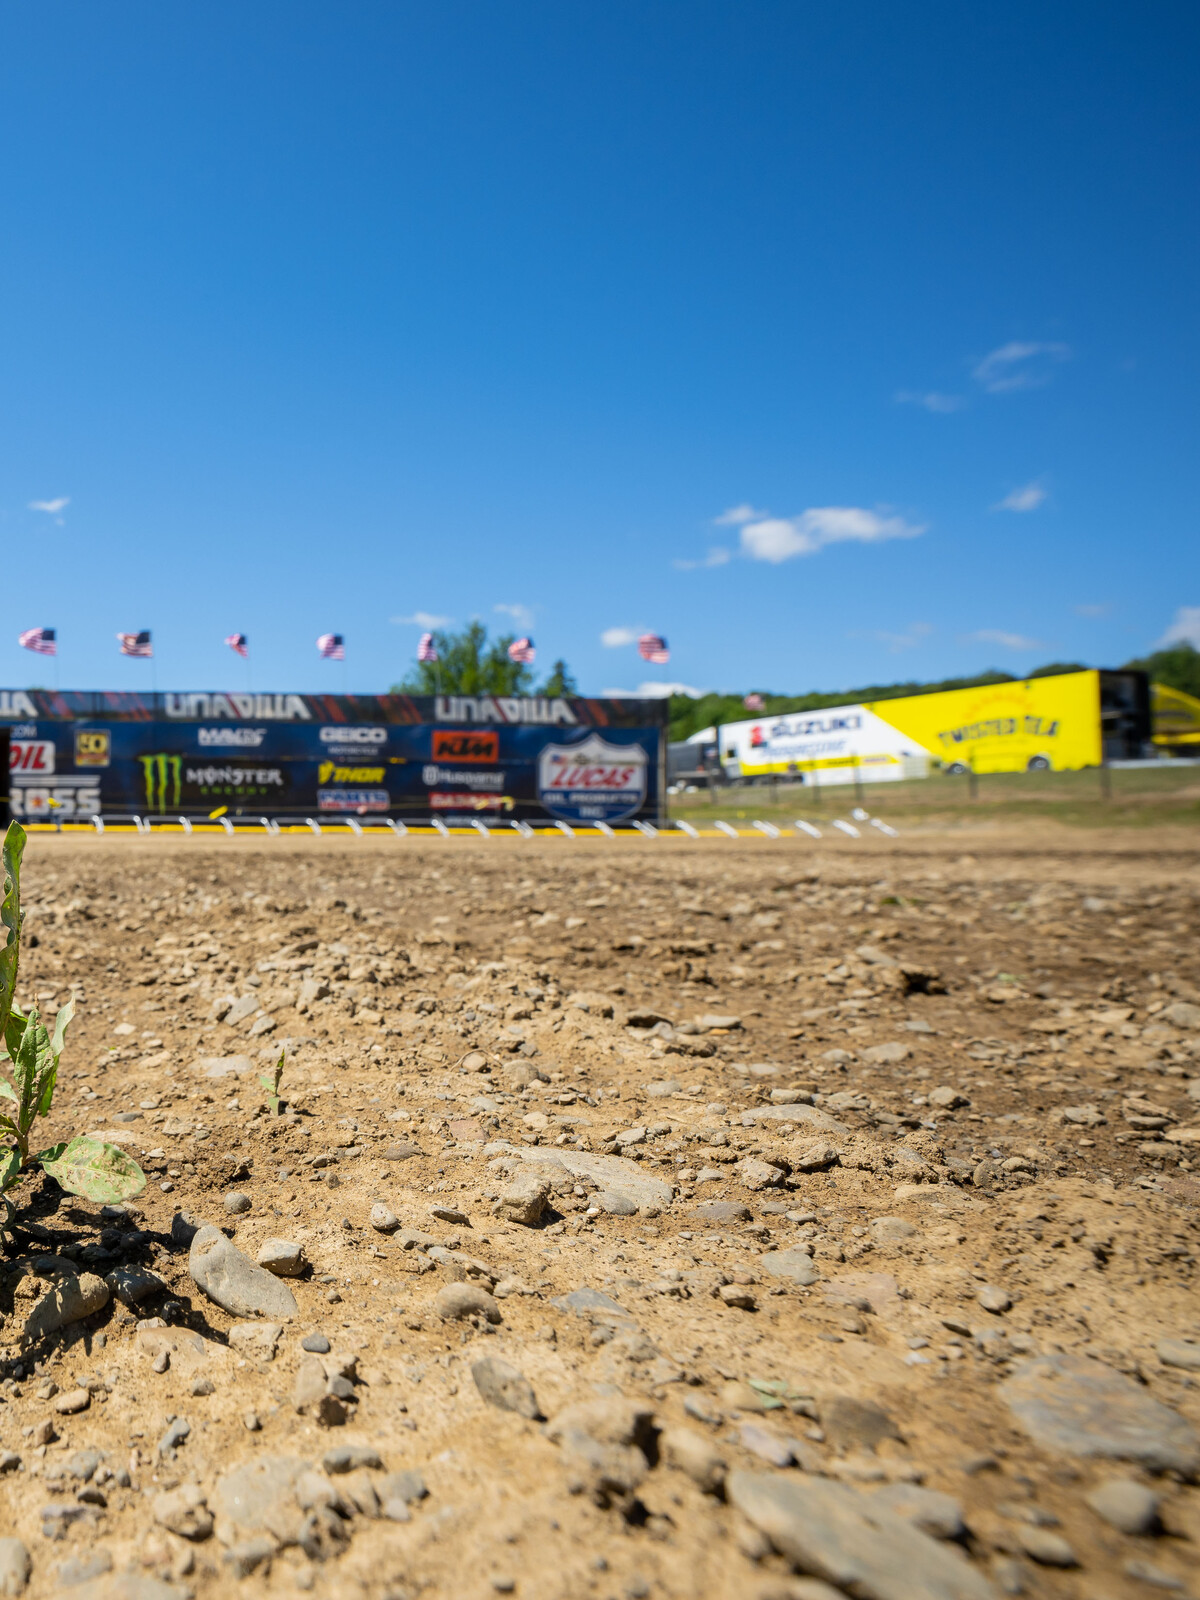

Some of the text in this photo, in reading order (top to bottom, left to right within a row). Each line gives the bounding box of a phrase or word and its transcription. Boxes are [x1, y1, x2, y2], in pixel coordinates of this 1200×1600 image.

[165, 693, 313, 720] UNADILLA
[435, 696, 578, 723] UNADILLA
[319, 727, 388, 743] GEICO
[770, 716, 862, 738] SUZUKI
[937, 714, 1060, 747] TWISTED TEA
[437, 737, 494, 757] KTM
[186, 766, 284, 786] MONSTER
[333, 766, 386, 783] THOR
[550, 766, 635, 787] LUCAS
[543, 793, 638, 804] OIL PRODUCTS
